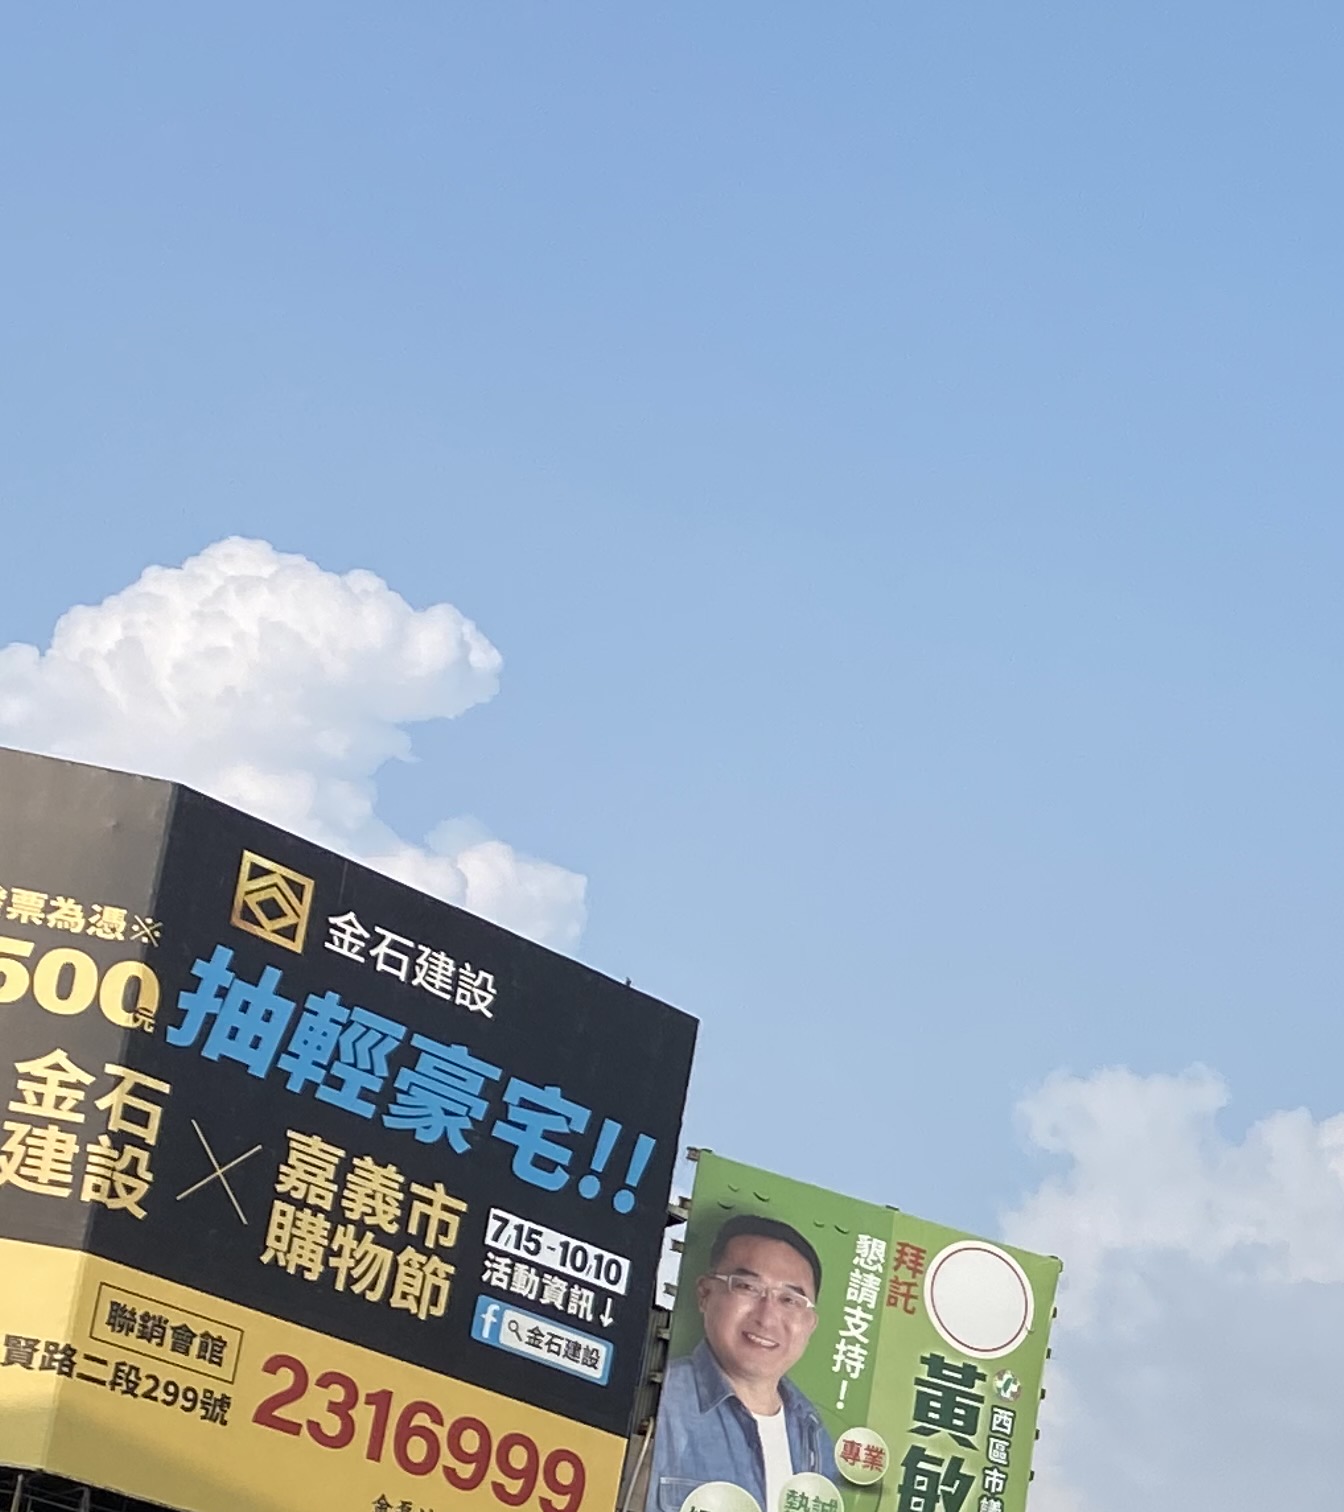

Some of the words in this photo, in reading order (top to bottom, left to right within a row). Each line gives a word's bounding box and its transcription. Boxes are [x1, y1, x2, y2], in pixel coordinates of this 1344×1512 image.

[324, 910, 499, 1019] 金石建設
[13, 1047, 171, 1147] 金石
[166, 943, 657, 1214] 抽輕豪宅!!
[0, 1119, 155, 1220] 建設
[272, 1128, 468, 1251] 嘉義市
[260, 1207, 457, 1321] 購物節
[482, 1252, 594, 1322] 活動資訊
[886, 1241, 927, 1315] 拜託
[105, 1300, 228, 1367] 聯銷會館
[525, 1326, 601, 1370] 金石建設
[840, 1439, 887, 1472] 專業
